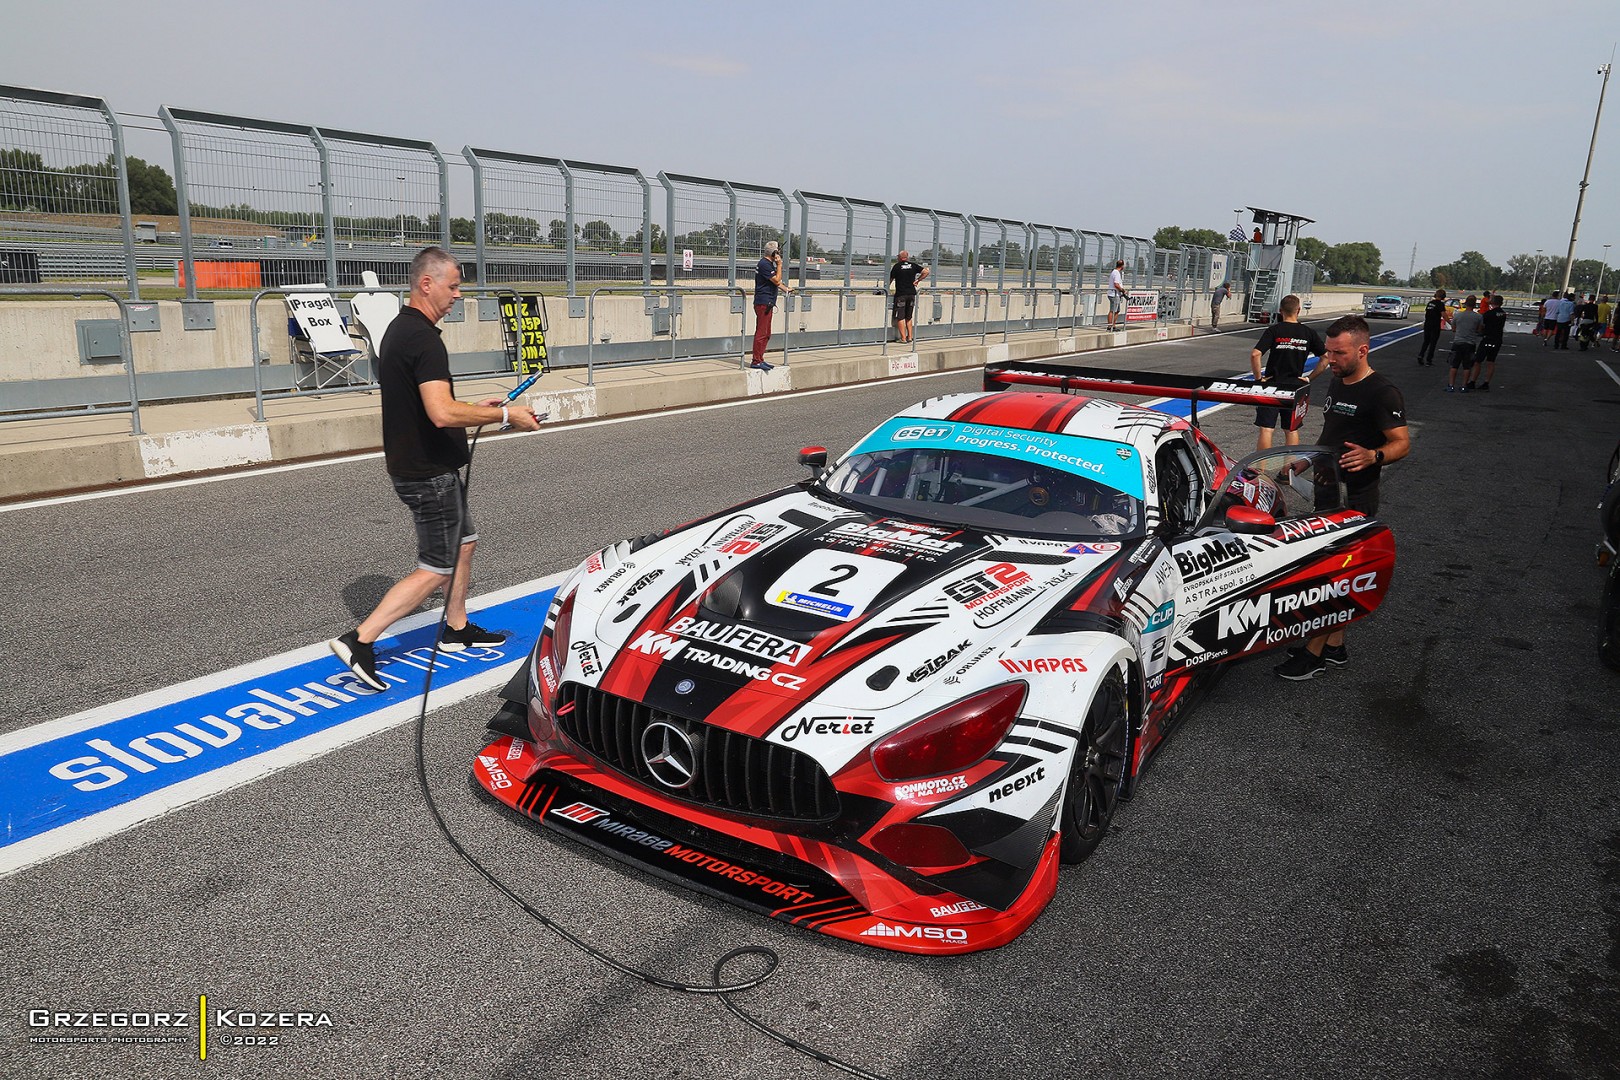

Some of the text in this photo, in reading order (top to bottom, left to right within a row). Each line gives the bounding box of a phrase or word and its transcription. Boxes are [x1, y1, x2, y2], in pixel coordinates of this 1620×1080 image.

[293, 299, 330, 310] Praga
[308, 317, 332, 327] Box
[962, 425, 1058, 447] Digital Security
[955, 435, 1021, 451] Progress.
[1025, 445, 1106, 475] Protected.
[813, 536, 867, 548] ASTRA
[834, 522, 964, 551] BigMat
[1173, 536, 1249, 577] BigMat
[1224, 562, 1254, 577] STAVEBNIN
[809, 564, 859, 597] 2
[942, 562, 1029, 604] GT2
[964, 575, 1033, 610] MOTORSPORT
[1184, 586, 1218, 605] ASTRA
[1219, 579, 1238, 593] spol.
[1245, 573, 1257, 582] r.o.
[797, 598, 844, 613] MICHELIN
[974, 586, 1037, 620] HOFFMANN
[1152, 607, 1173, 625] CUP
[1217, 571, 1377, 640] KM TRADING CZ
[668, 616, 808, 666] BAUFERA
[1266, 607, 1355, 645] kovoperner
[627, 630, 808, 691] KM TRADING CZ
[956, 646, 997, 675] ORLIMEX
[1151, 636, 1167, 662] 2
[781, 716, 875, 742] Neriet
[918, 789, 934, 797] NA
[936, 782, 968, 794] MOTO
[989, 766, 1046, 803] neext
[664, 844, 815, 904] MOTORSPORT
[894, 926, 967, 940] MSO
